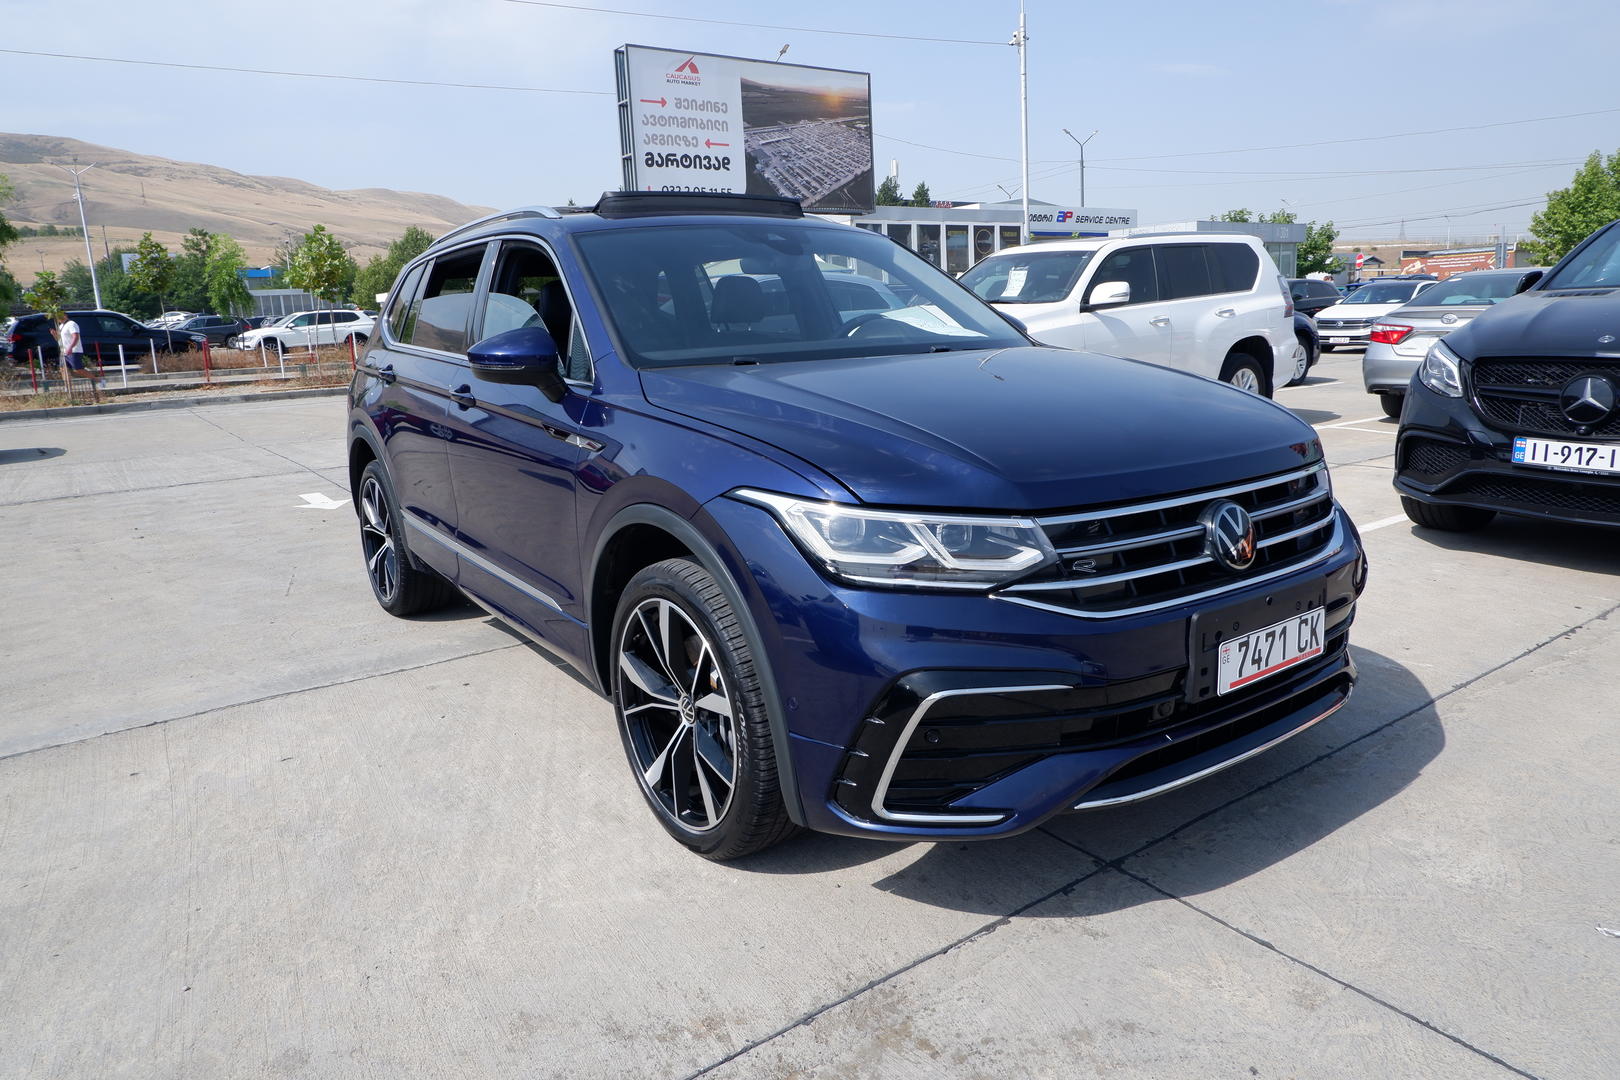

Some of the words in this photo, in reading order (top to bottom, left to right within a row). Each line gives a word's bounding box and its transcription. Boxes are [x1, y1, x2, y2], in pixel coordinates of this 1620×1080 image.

[666, 73, 701, 82] CAUCASUS
[674, 97, 728, 114] შეიძინე
[642, 114, 729, 132] ავტომობილი
[643, 133, 699, 148] ადგილზე
[645, 152, 731, 171] მარტივად
[1075, 215, 1104, 224] SERVICE
[1104, 216, 1130, 225] CENTRE
[1514, 451, 1525, 460] GE
[1222, 654, 1230, 665] GE
[1237, 625, 1287, 678] 7471
[1297, 613, 1321, 653] CK
